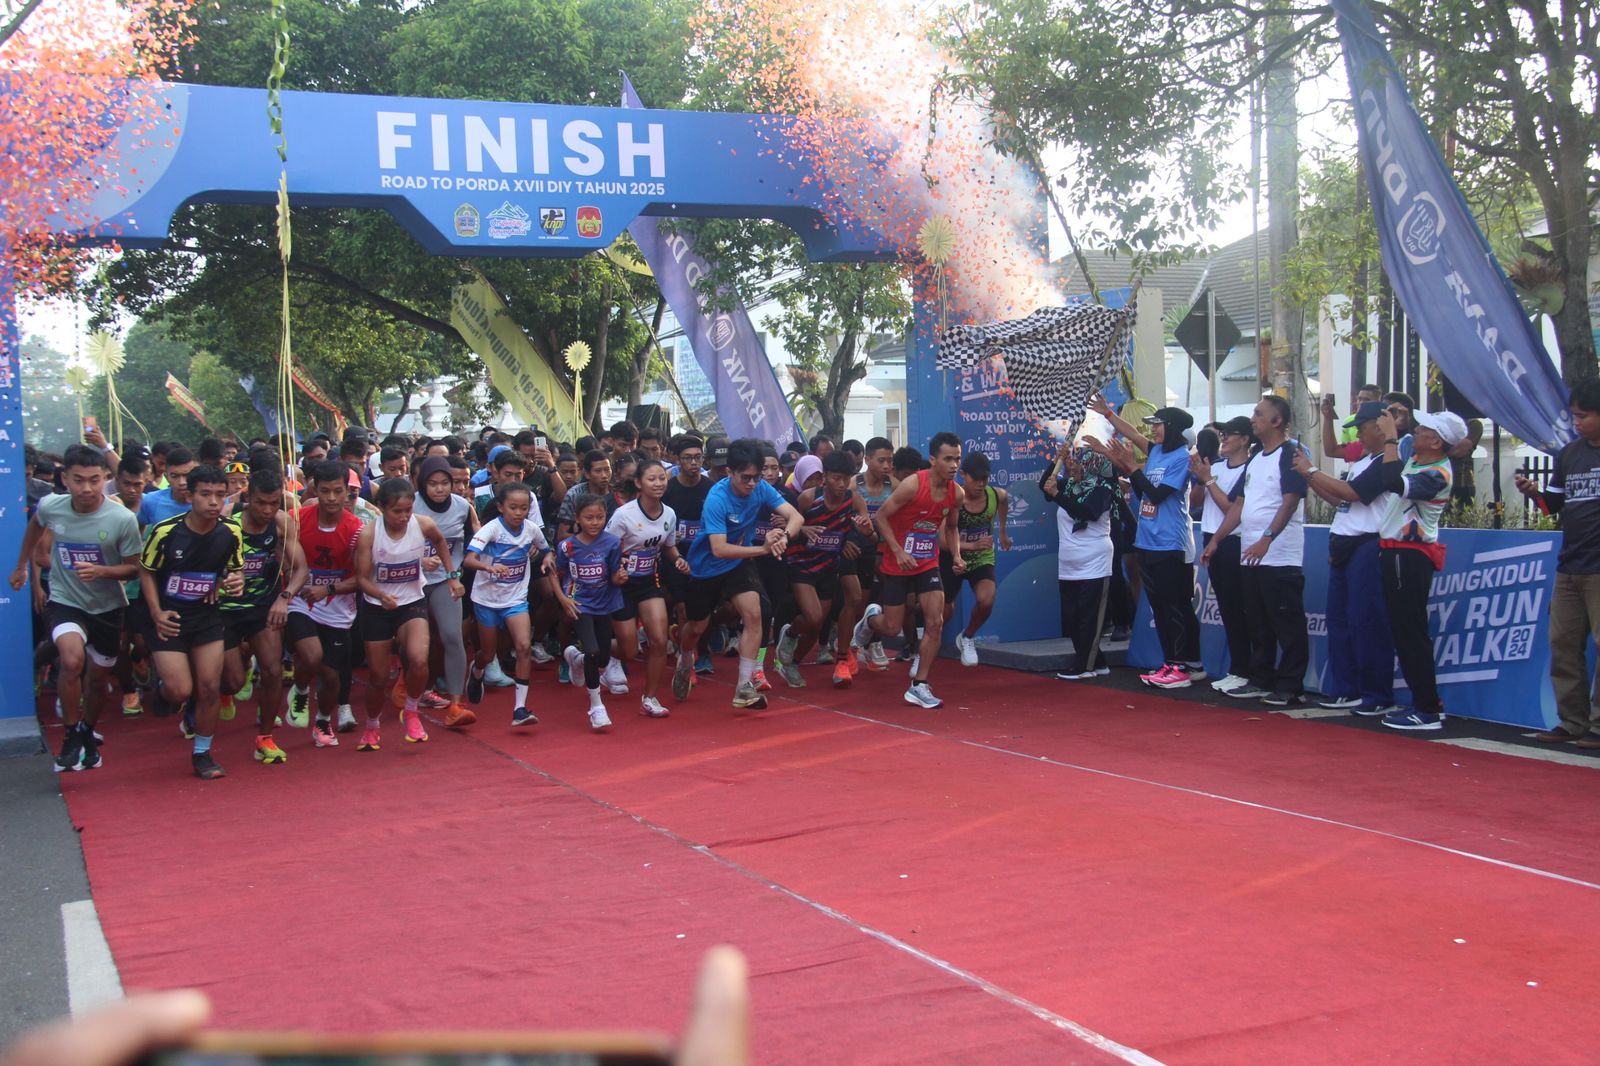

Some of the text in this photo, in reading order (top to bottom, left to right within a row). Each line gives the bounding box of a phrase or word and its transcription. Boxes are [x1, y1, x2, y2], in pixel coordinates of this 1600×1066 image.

[376, 111, 666, 178] FINISH
[381, 174, 665, 196] ROAD TO PORDA XVII DIY TAHUN 2025
[962, 411, 993, 422] ROAD
[994, 411, 1009, 421] TO
[1008, 423, 1026, 433] DIY
[1009, 472, 1026, 481] BPD
[1565, 478, 1600, 490] CITY RU
[73, 553, 98, 562] 1615
[579, 566, 603, 576] 2230
[169, 577, 180, 591] 10K
[182, 581, 210, 592] 1346
[1426, 588, 1545, 633] TY RUN
[1510, 627, 1531, 643] 20
[1507, 643, 1528, 658] 24
